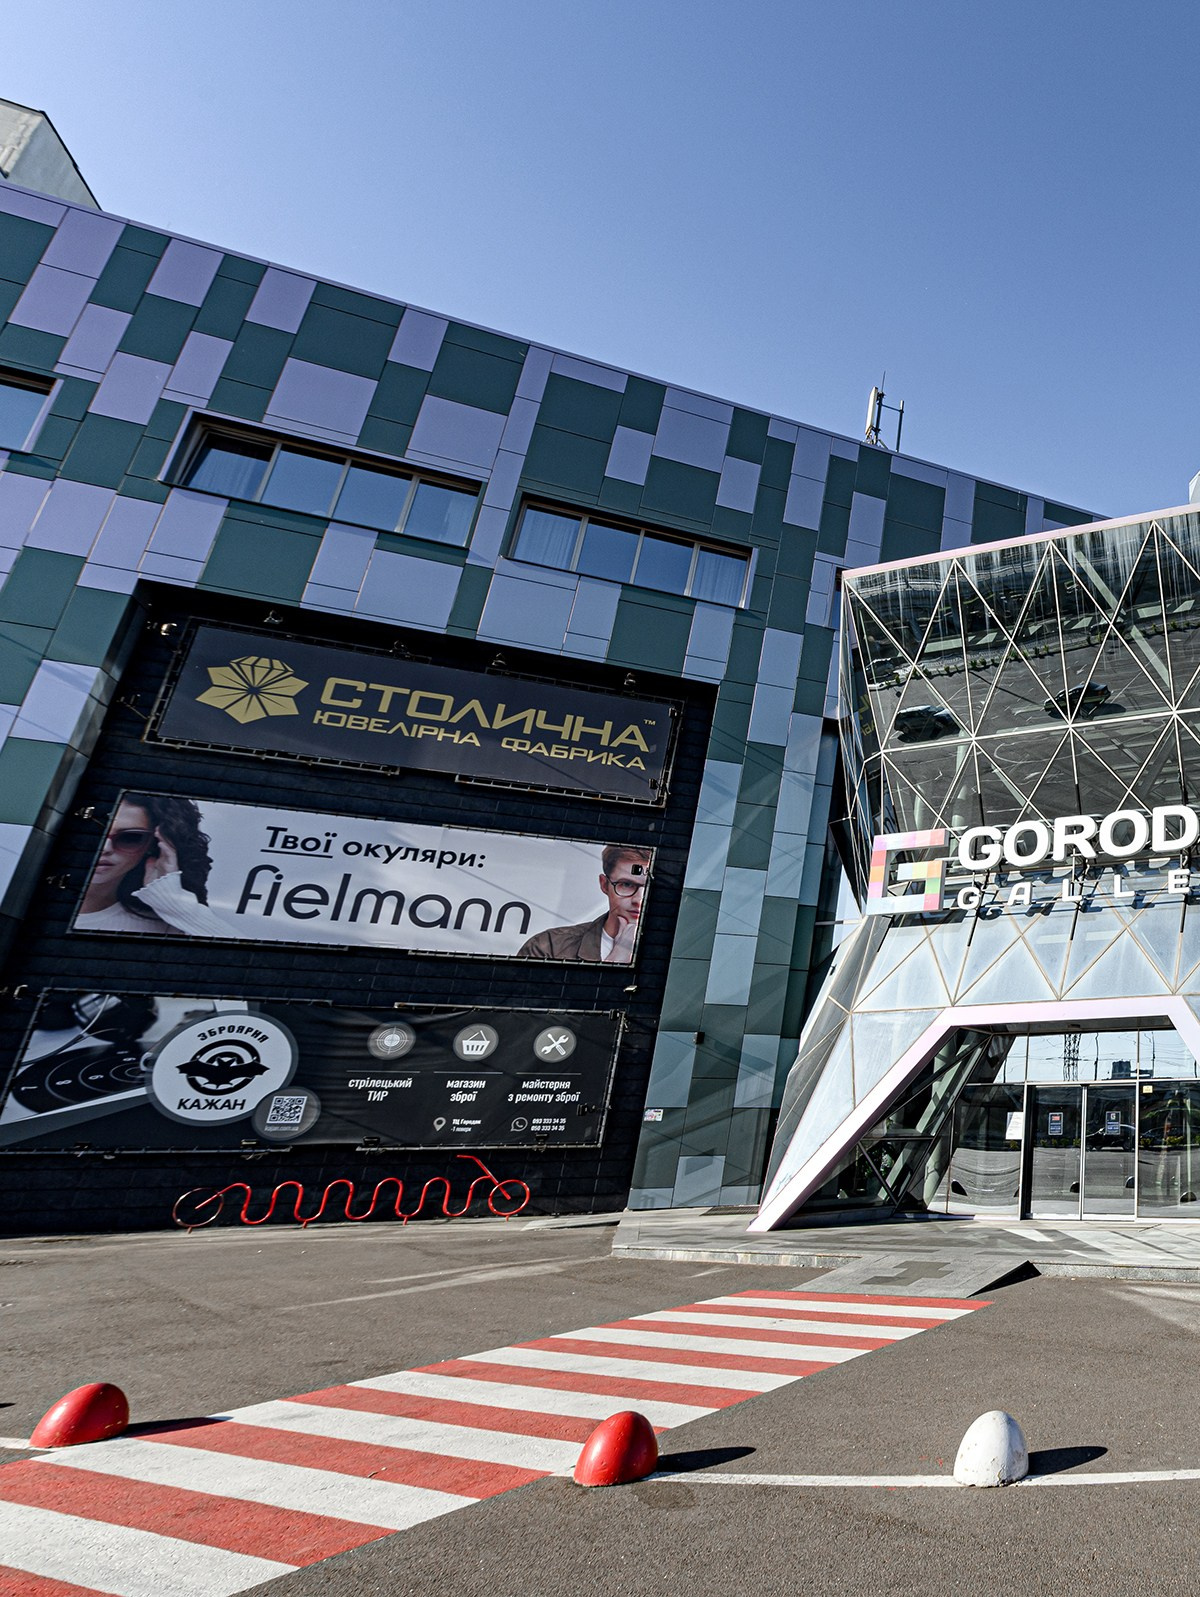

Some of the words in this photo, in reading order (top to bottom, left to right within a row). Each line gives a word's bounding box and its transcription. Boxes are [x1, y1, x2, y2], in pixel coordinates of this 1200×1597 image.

[320, 677, 650, 752] СТОЛИЧНА
[313, 710, 481, 747] ЮВЕЛІРНА
[501, 737, 646, 770] ФАБРИКА
[265, 826, 338, 853] Твої
[342, 840, 486, 869] окуляри:
[235, 864, 532, 935] fielmann
[197, 1024, 270, 1044] ЗБРОЯРНЯ
[348, 1077, 413, 1089] стрілецький
[446, 1079, 486, 1089] магазин
[521, 1079, 571, 1090] майстерня
[367, 1090, 389, 1102] ТИР
[450, 1091, 479, 1103] зброї
[508, 1094, 514, 1102] з
[515, 1093, 554, 1104] ремонту
[555, 1091, 581, 1103] зброї
[177, 1098, 246, 1110] КАЖАН
